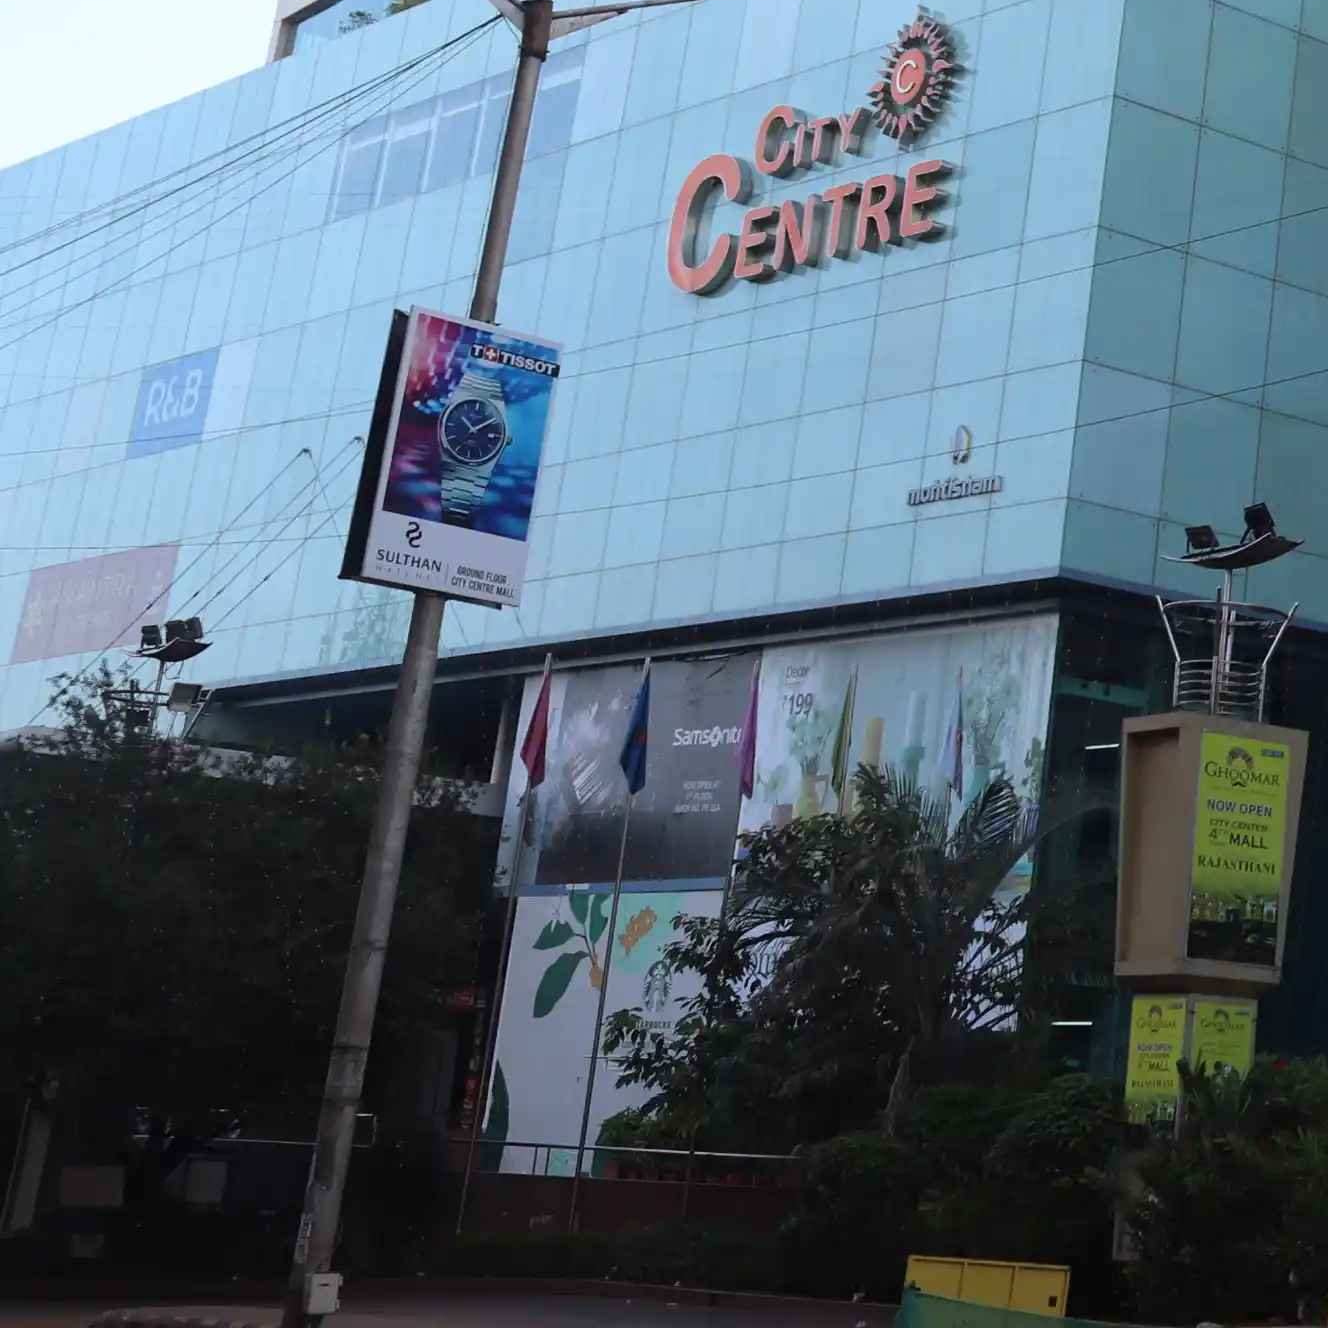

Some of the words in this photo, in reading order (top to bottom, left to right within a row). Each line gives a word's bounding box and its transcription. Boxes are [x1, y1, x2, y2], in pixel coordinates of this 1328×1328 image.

[667, 154, 953, 296] CENTRE
[500, 352, 557, 377] TISSOT
[143, 368, 201, 427] R&B
[376, 548, 442, 573] SULTHAN
[451, 575, 465, 588] CITY
[466, 577, 495, 594] CENTRE
[486, 569, 508, 584] FLOOR
[1204, 760, 1280, 787] GHOOMAR
[1207, 799, 1238, 813] NOW
[1239, 803, 1273, 817] OPEN
[1229, 832, 1269, 850] MALL
[1198, 855, 1276, 875] RAJASTHANI
